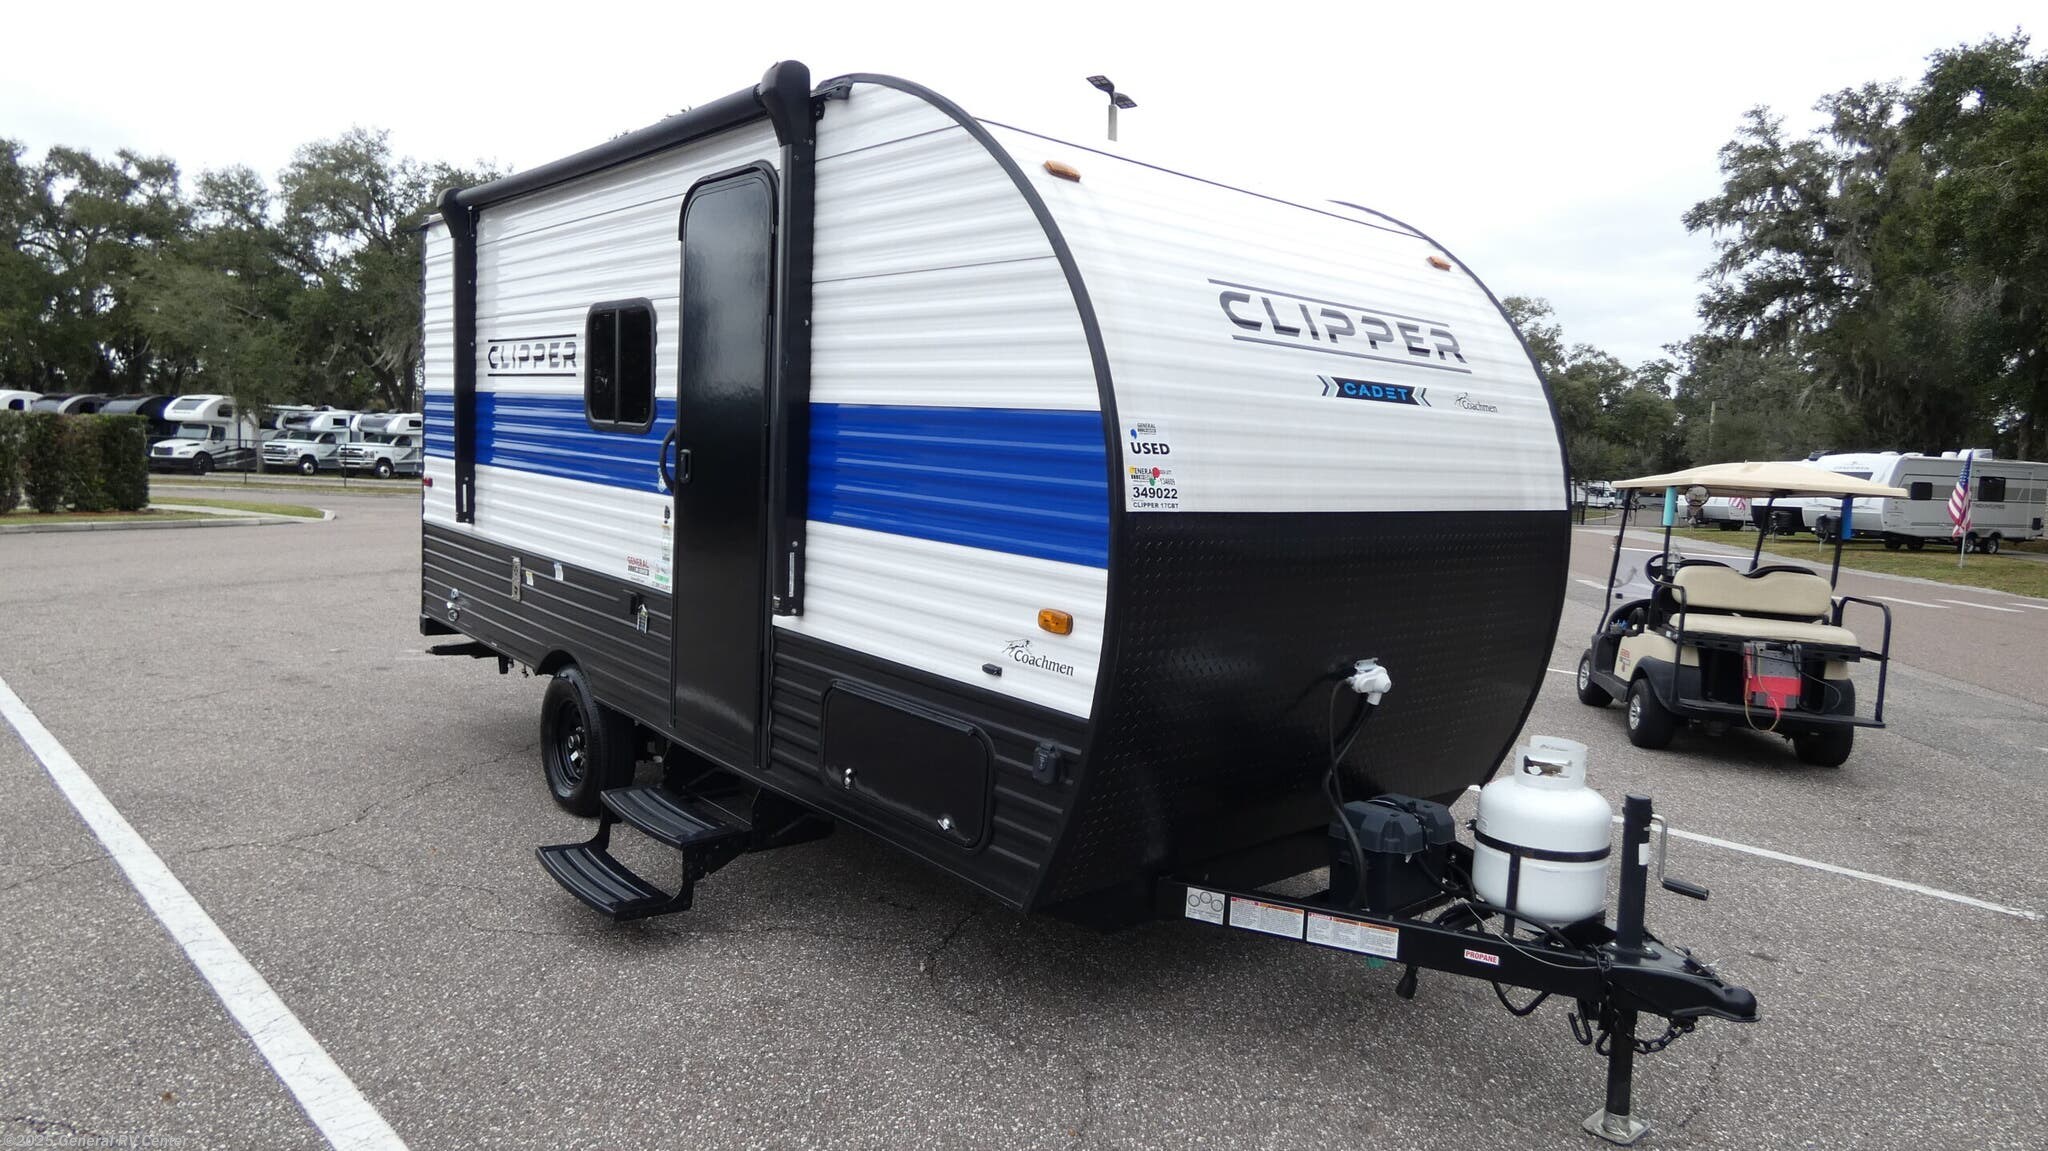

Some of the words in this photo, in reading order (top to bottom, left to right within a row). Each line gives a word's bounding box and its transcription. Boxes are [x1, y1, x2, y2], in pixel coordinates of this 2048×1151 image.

[1219, 290, 1468, 363] CLIPPER
[488, 341, 577, 370] CLIPPER
[1343, 381, 1409, 401] CADET
[1462, 400, 1498, 413] Coachmen
[1130, 442, 1170, 455] USED
[1133, 487, 1178, 499] 349022
[1014, 649, 1074, 676] Coachmen
[1465, 950, 1498, 963] PROPANE
